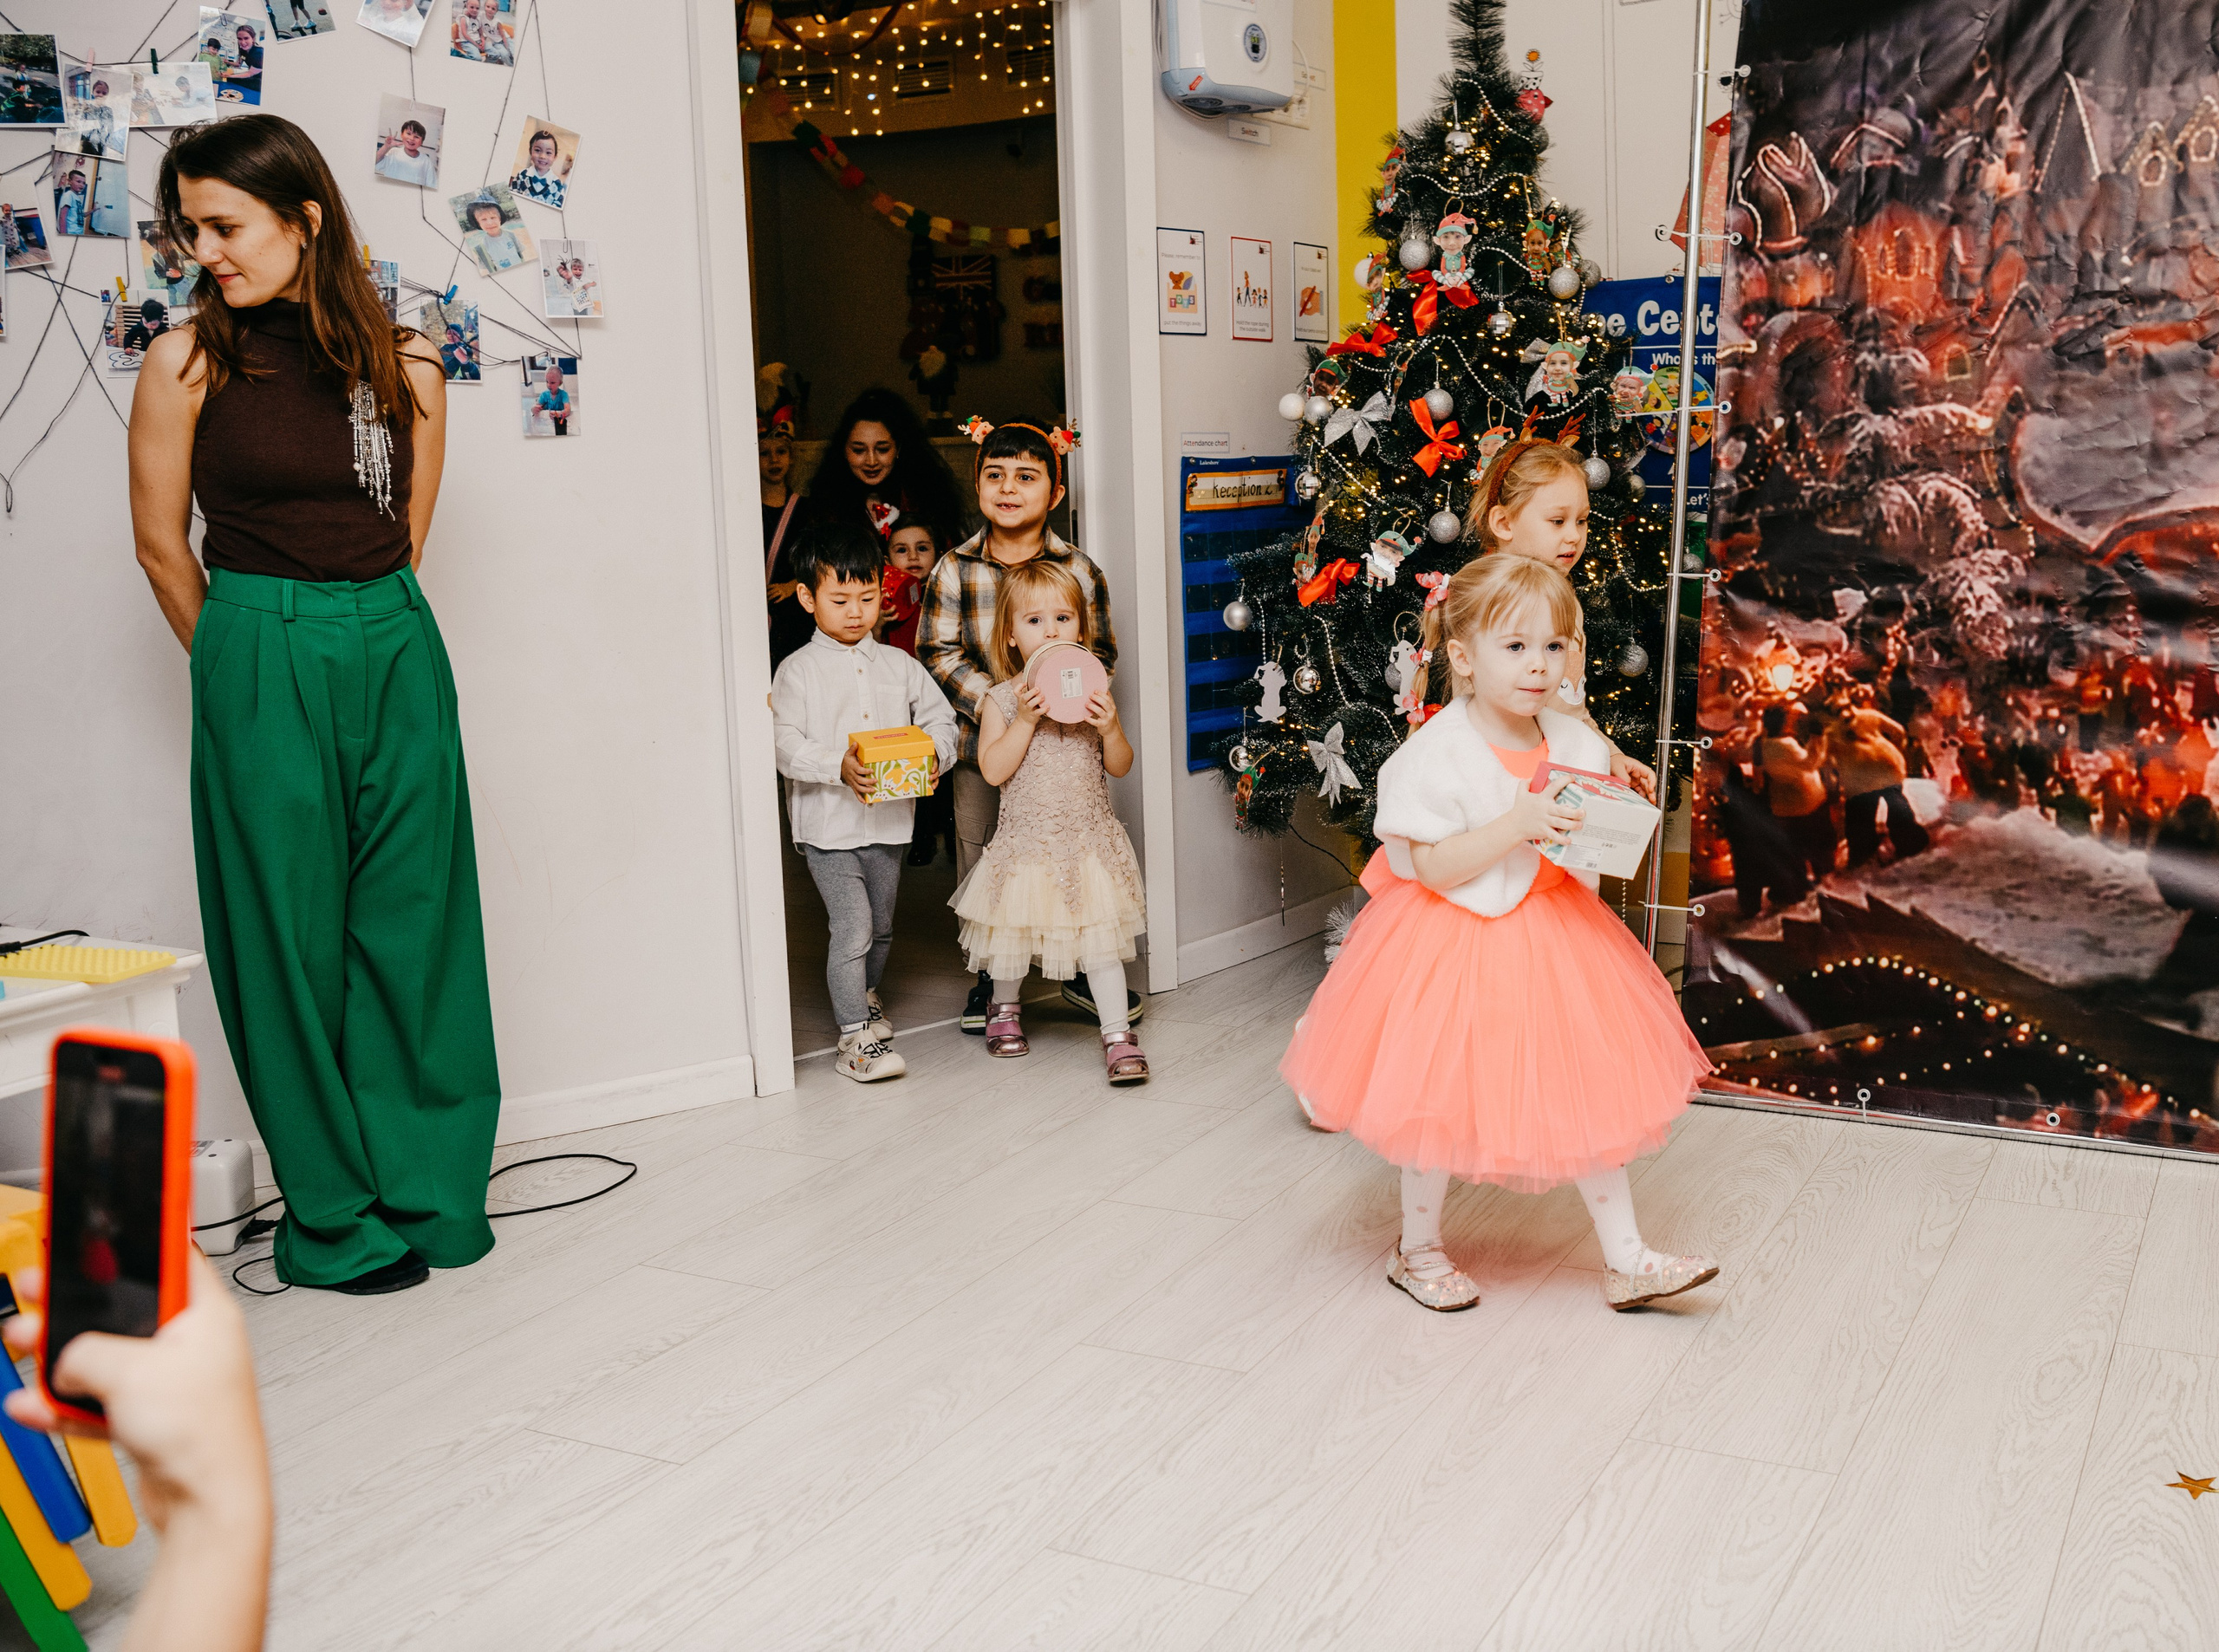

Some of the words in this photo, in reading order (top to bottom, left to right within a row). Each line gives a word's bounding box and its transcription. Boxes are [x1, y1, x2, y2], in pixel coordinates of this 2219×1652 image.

[1170, 295, 1194, 308] TOYS
[1637, 299, 1720, 336] Cet
[1702, 352, 1715, 365] th
